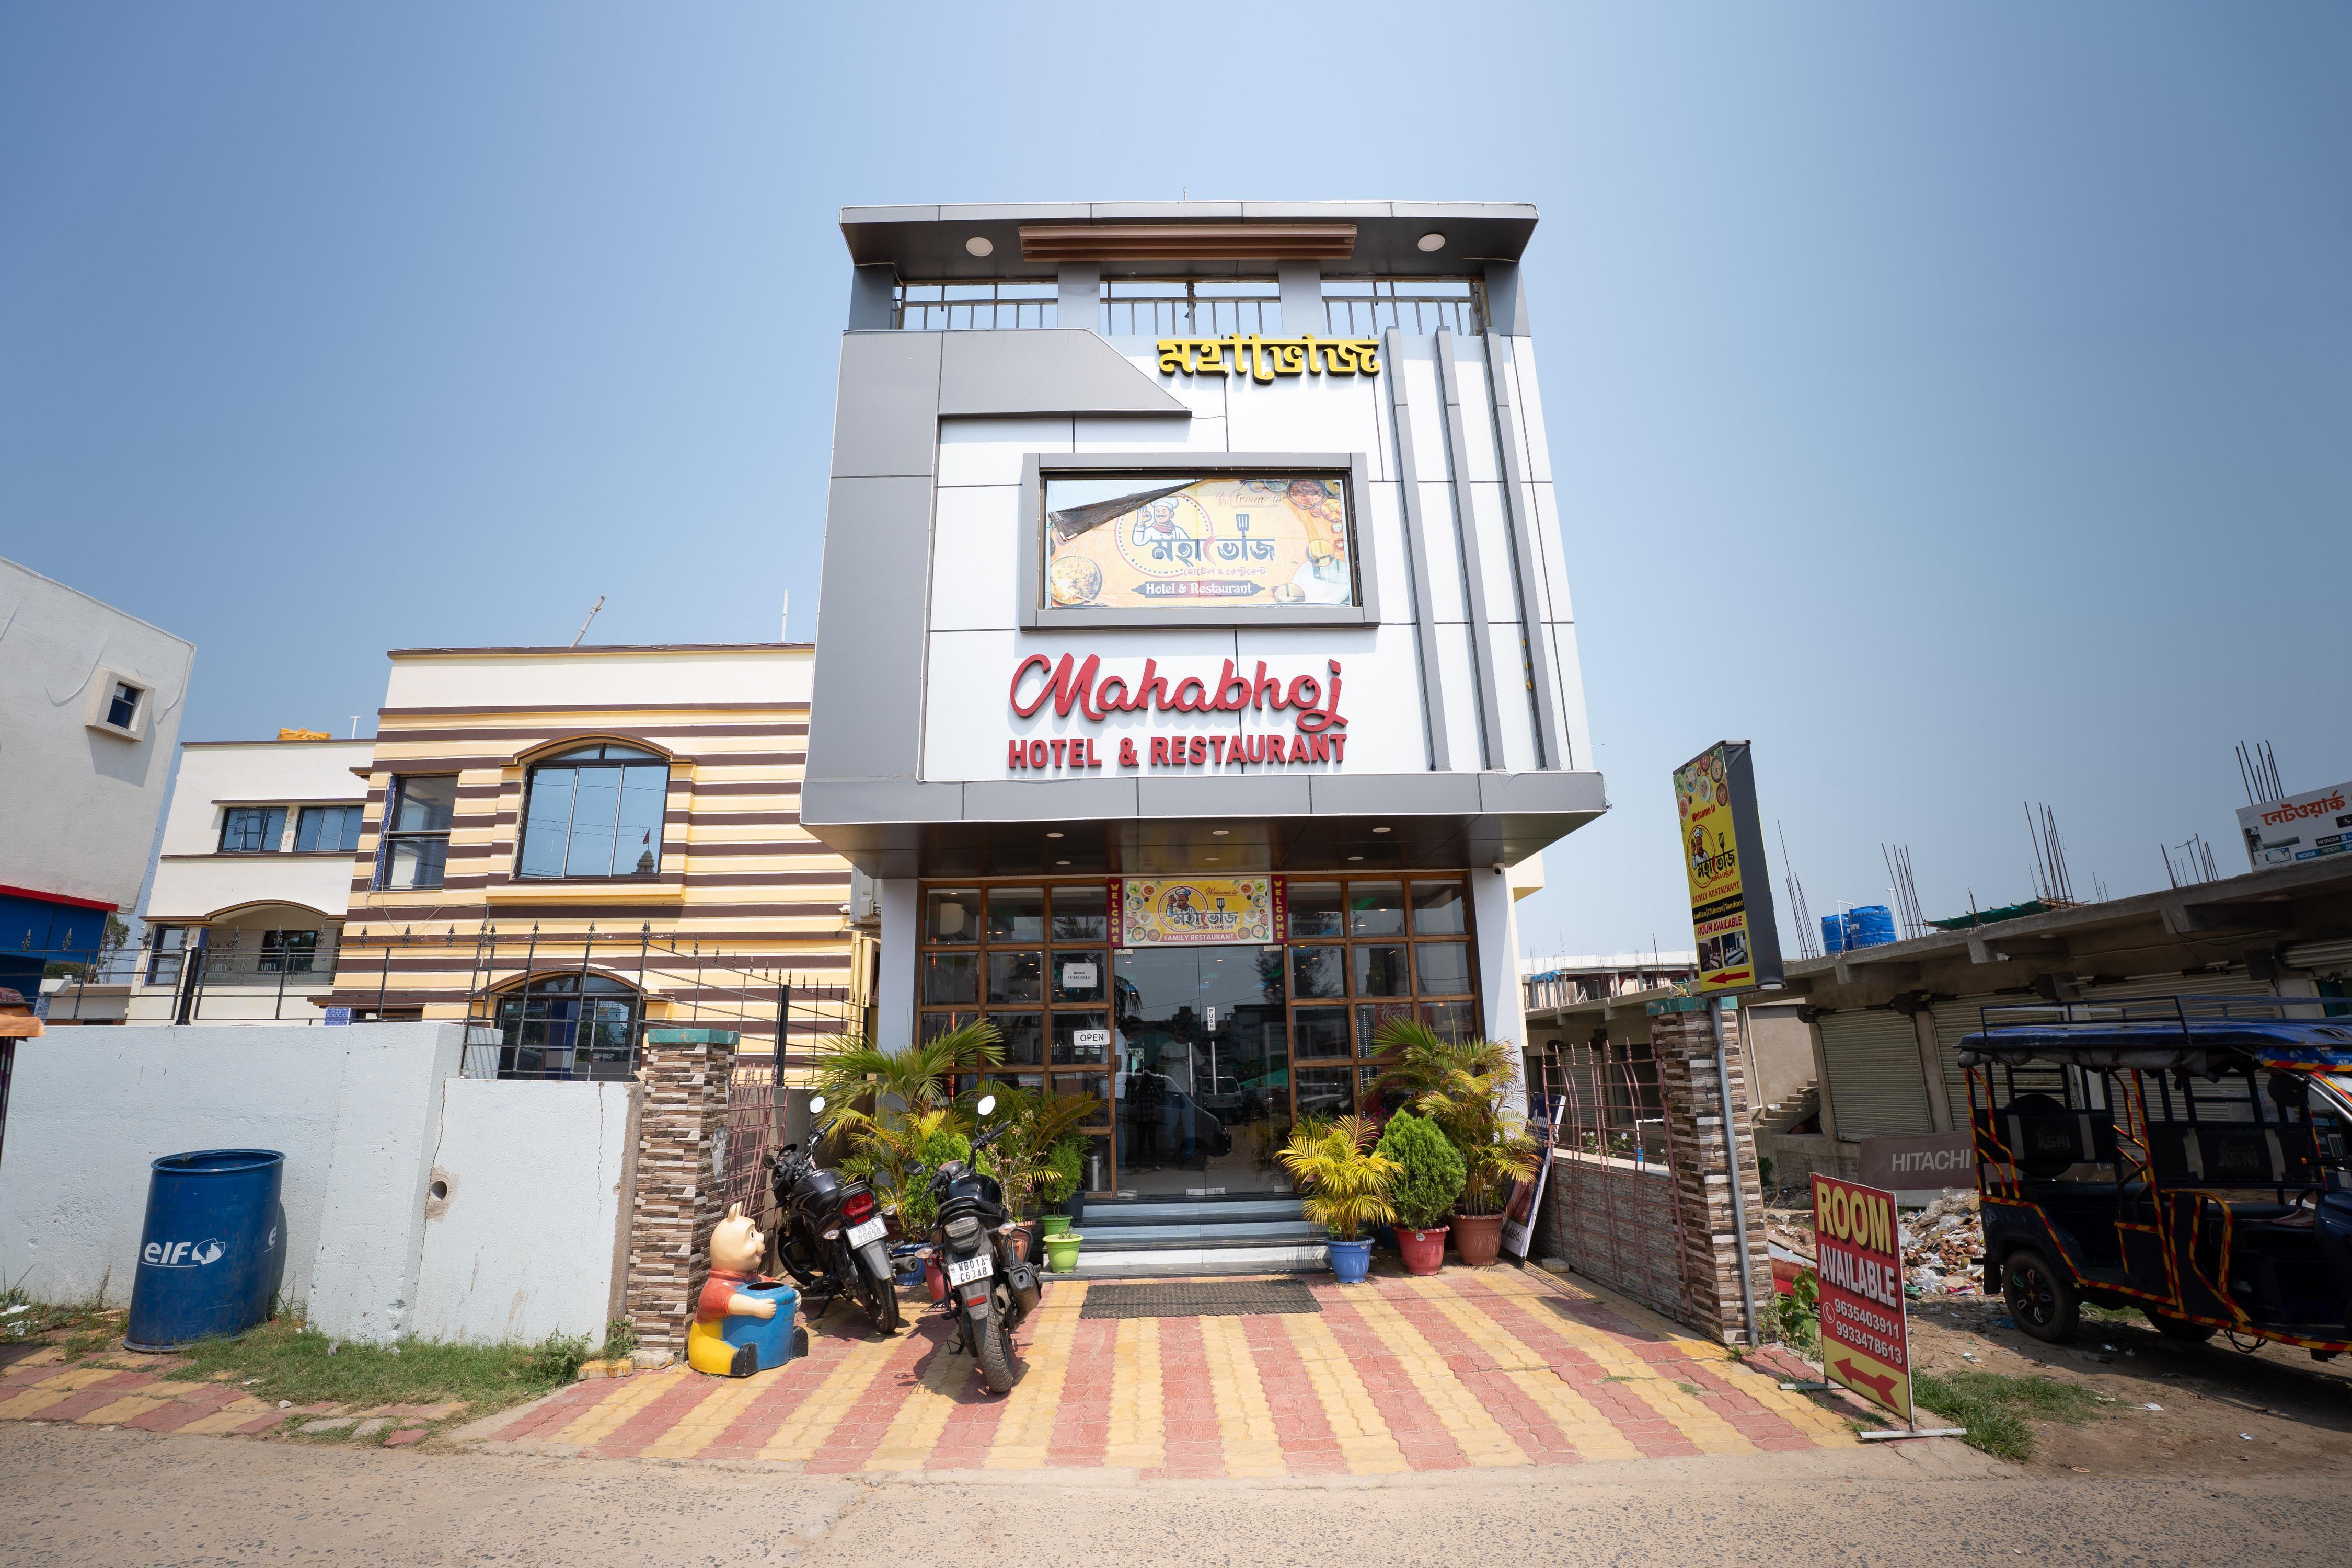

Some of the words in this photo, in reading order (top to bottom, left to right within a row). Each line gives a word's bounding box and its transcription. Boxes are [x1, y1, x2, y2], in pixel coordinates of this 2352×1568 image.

[1157, 333, 1381, 384] মহাভোজ
[1149, 535, 1276, 568] মহাভোজ
[1183, 567, 1215, 576] হোটেল
[1145, 583, 1175, 594] Hotel
[1178, 583, 1187, 594] &
[1189, 582, 1253, 594] Restaurant
[1010, 652, 1349, 733] Mahabhoj
[1008, 737, 1102, 769] HOTEL
[1119, 737, 1139, 767] &
[1150, 733, 1347, 766] RESTAURANT
[1691, 806, 1711, 823] Welcome
[1710, 804, 1716, 813] to
[2260, 790, 2346, 826] নেটওয়ার্ক
[2317, 836, 2340, 845] HITACHI
[1697, 847, 1735, 880] মহাভোজ
[2298, 851, 2317, 859] NOKIA
[1205, 887, 1231, 895] Welcome
[1692, 892, 1708, 904] FAMILY
[1708, 881, 1740, 898] RESTAURANT
[1110, 883, 1120, 942] WELCOME
[1174, 910, 1238, 928] মহাভোজ
[1274, 880, 1284, 939] WELCOME
[1693, 911, 1707, 920] Indian
[1707, 905, 1724, 916] Chinese
[1724, 900, 1744, 910] Tandoor
[1698, 923, 1712, 936] ROOM
[1713, 915, 1743, 932] AVAILABLE
[260, 962, 276, 971] ARYA
[1080, 1033, 1104, 1042] OPEN
[2036, 1134, 2071, 1150] AGNI
[1892, 1149, 1971, 1171] HITACHI
[2218, 1148, 2259, 1168] AGNI
[857, 1225, 867, 1234] WB
[867, 1220, 877, 1229] 25
[1816, 1181, 1894, 1254] ROOM
[144, 1241, 192, 1264] elf
[958, 1257, 986, 1272] WB01A
[960, 1266, 987, 1282] C6348
[1819, 1243, 1897, 1308] AVAILABLE
[1834, 1297, 1901, 1340] 9635403911
[1835, 1320, 1903, 1365] 9933478613
